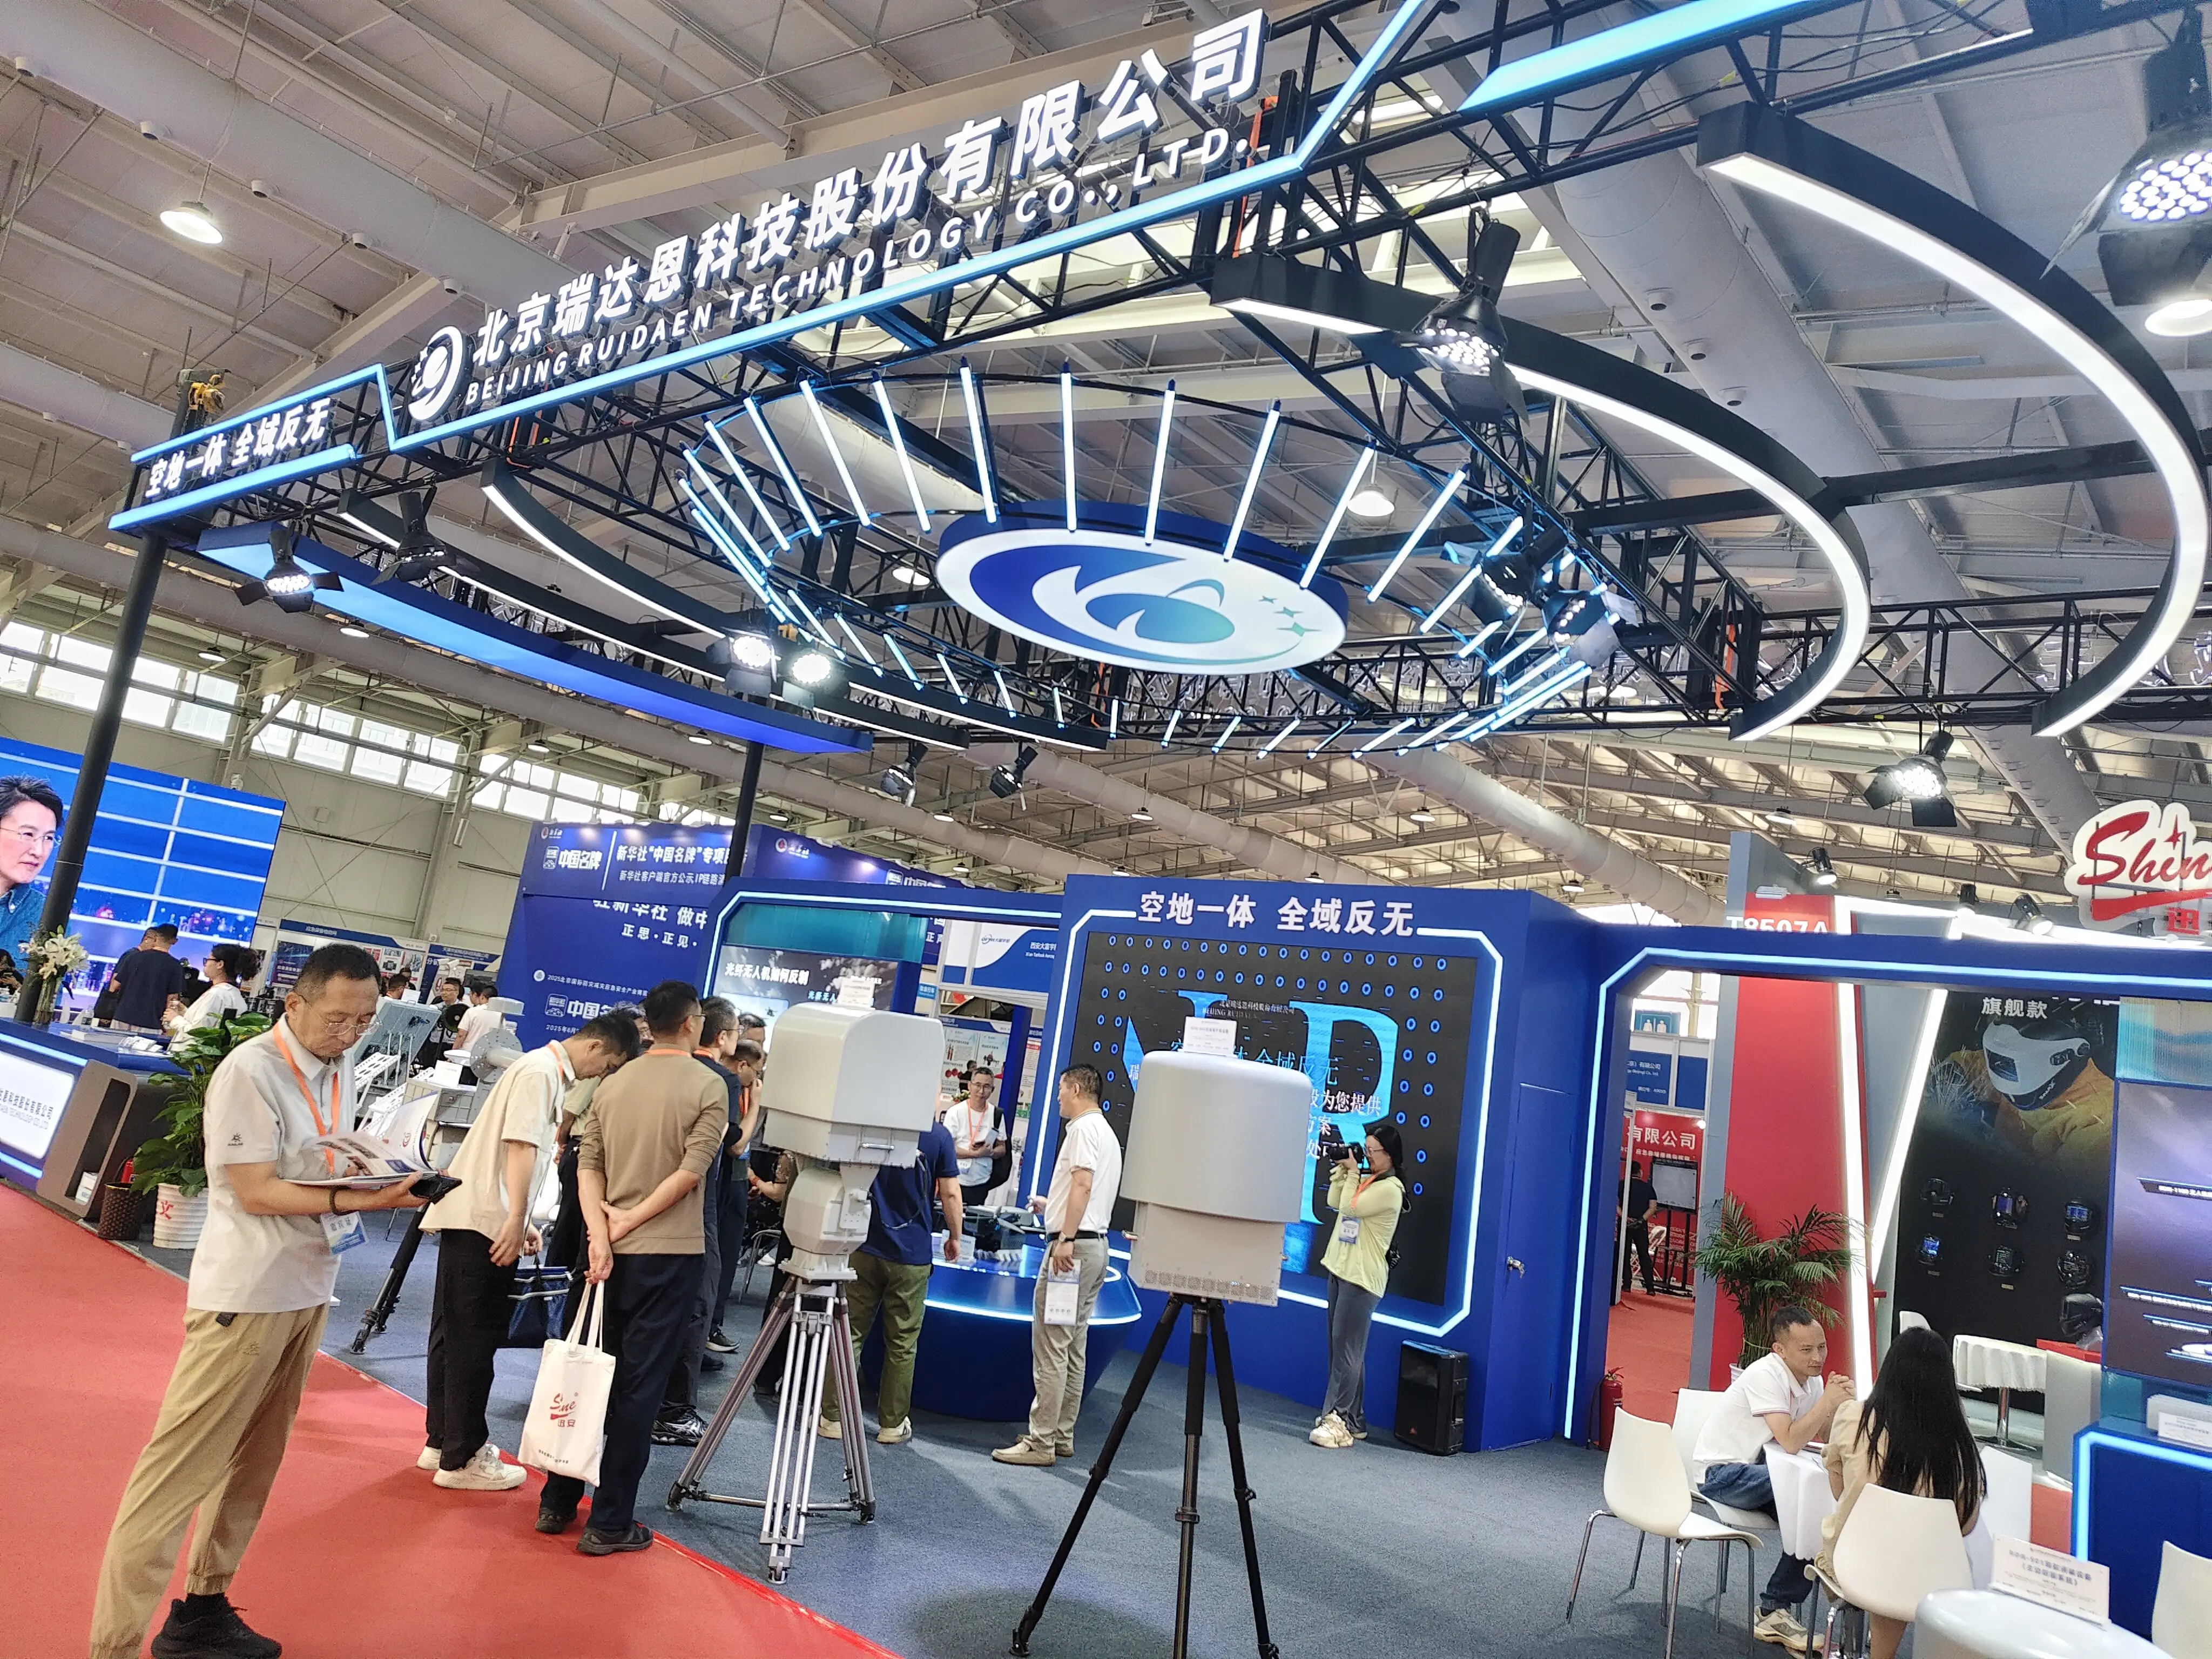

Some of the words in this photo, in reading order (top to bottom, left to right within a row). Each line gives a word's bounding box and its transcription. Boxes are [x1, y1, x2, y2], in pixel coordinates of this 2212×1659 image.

[473, 9, 1265, 367] 北京瑞达恩科技股份有限公司
[465, 350, 567, 407] BEIJING
[577, 302, 713, 367] RUIDAEN
[729, 206, 994, 320] TECHNOLOGY
[145, 433, 228, 498] 空地一体
[231, 397, 331, 466] 全域反无
[558, 849, 602, 869] 中国名牌
[1137, 891, 1257, 929] 空地一体
[1276, 896, 1414, 936] 全域反无
[725, 962, 810, 986] 光纤无人机如何反制
[1981, 996, 2048, 1019] 旗舰款
[1627, 1125, 1695, 1150] 有限公司
